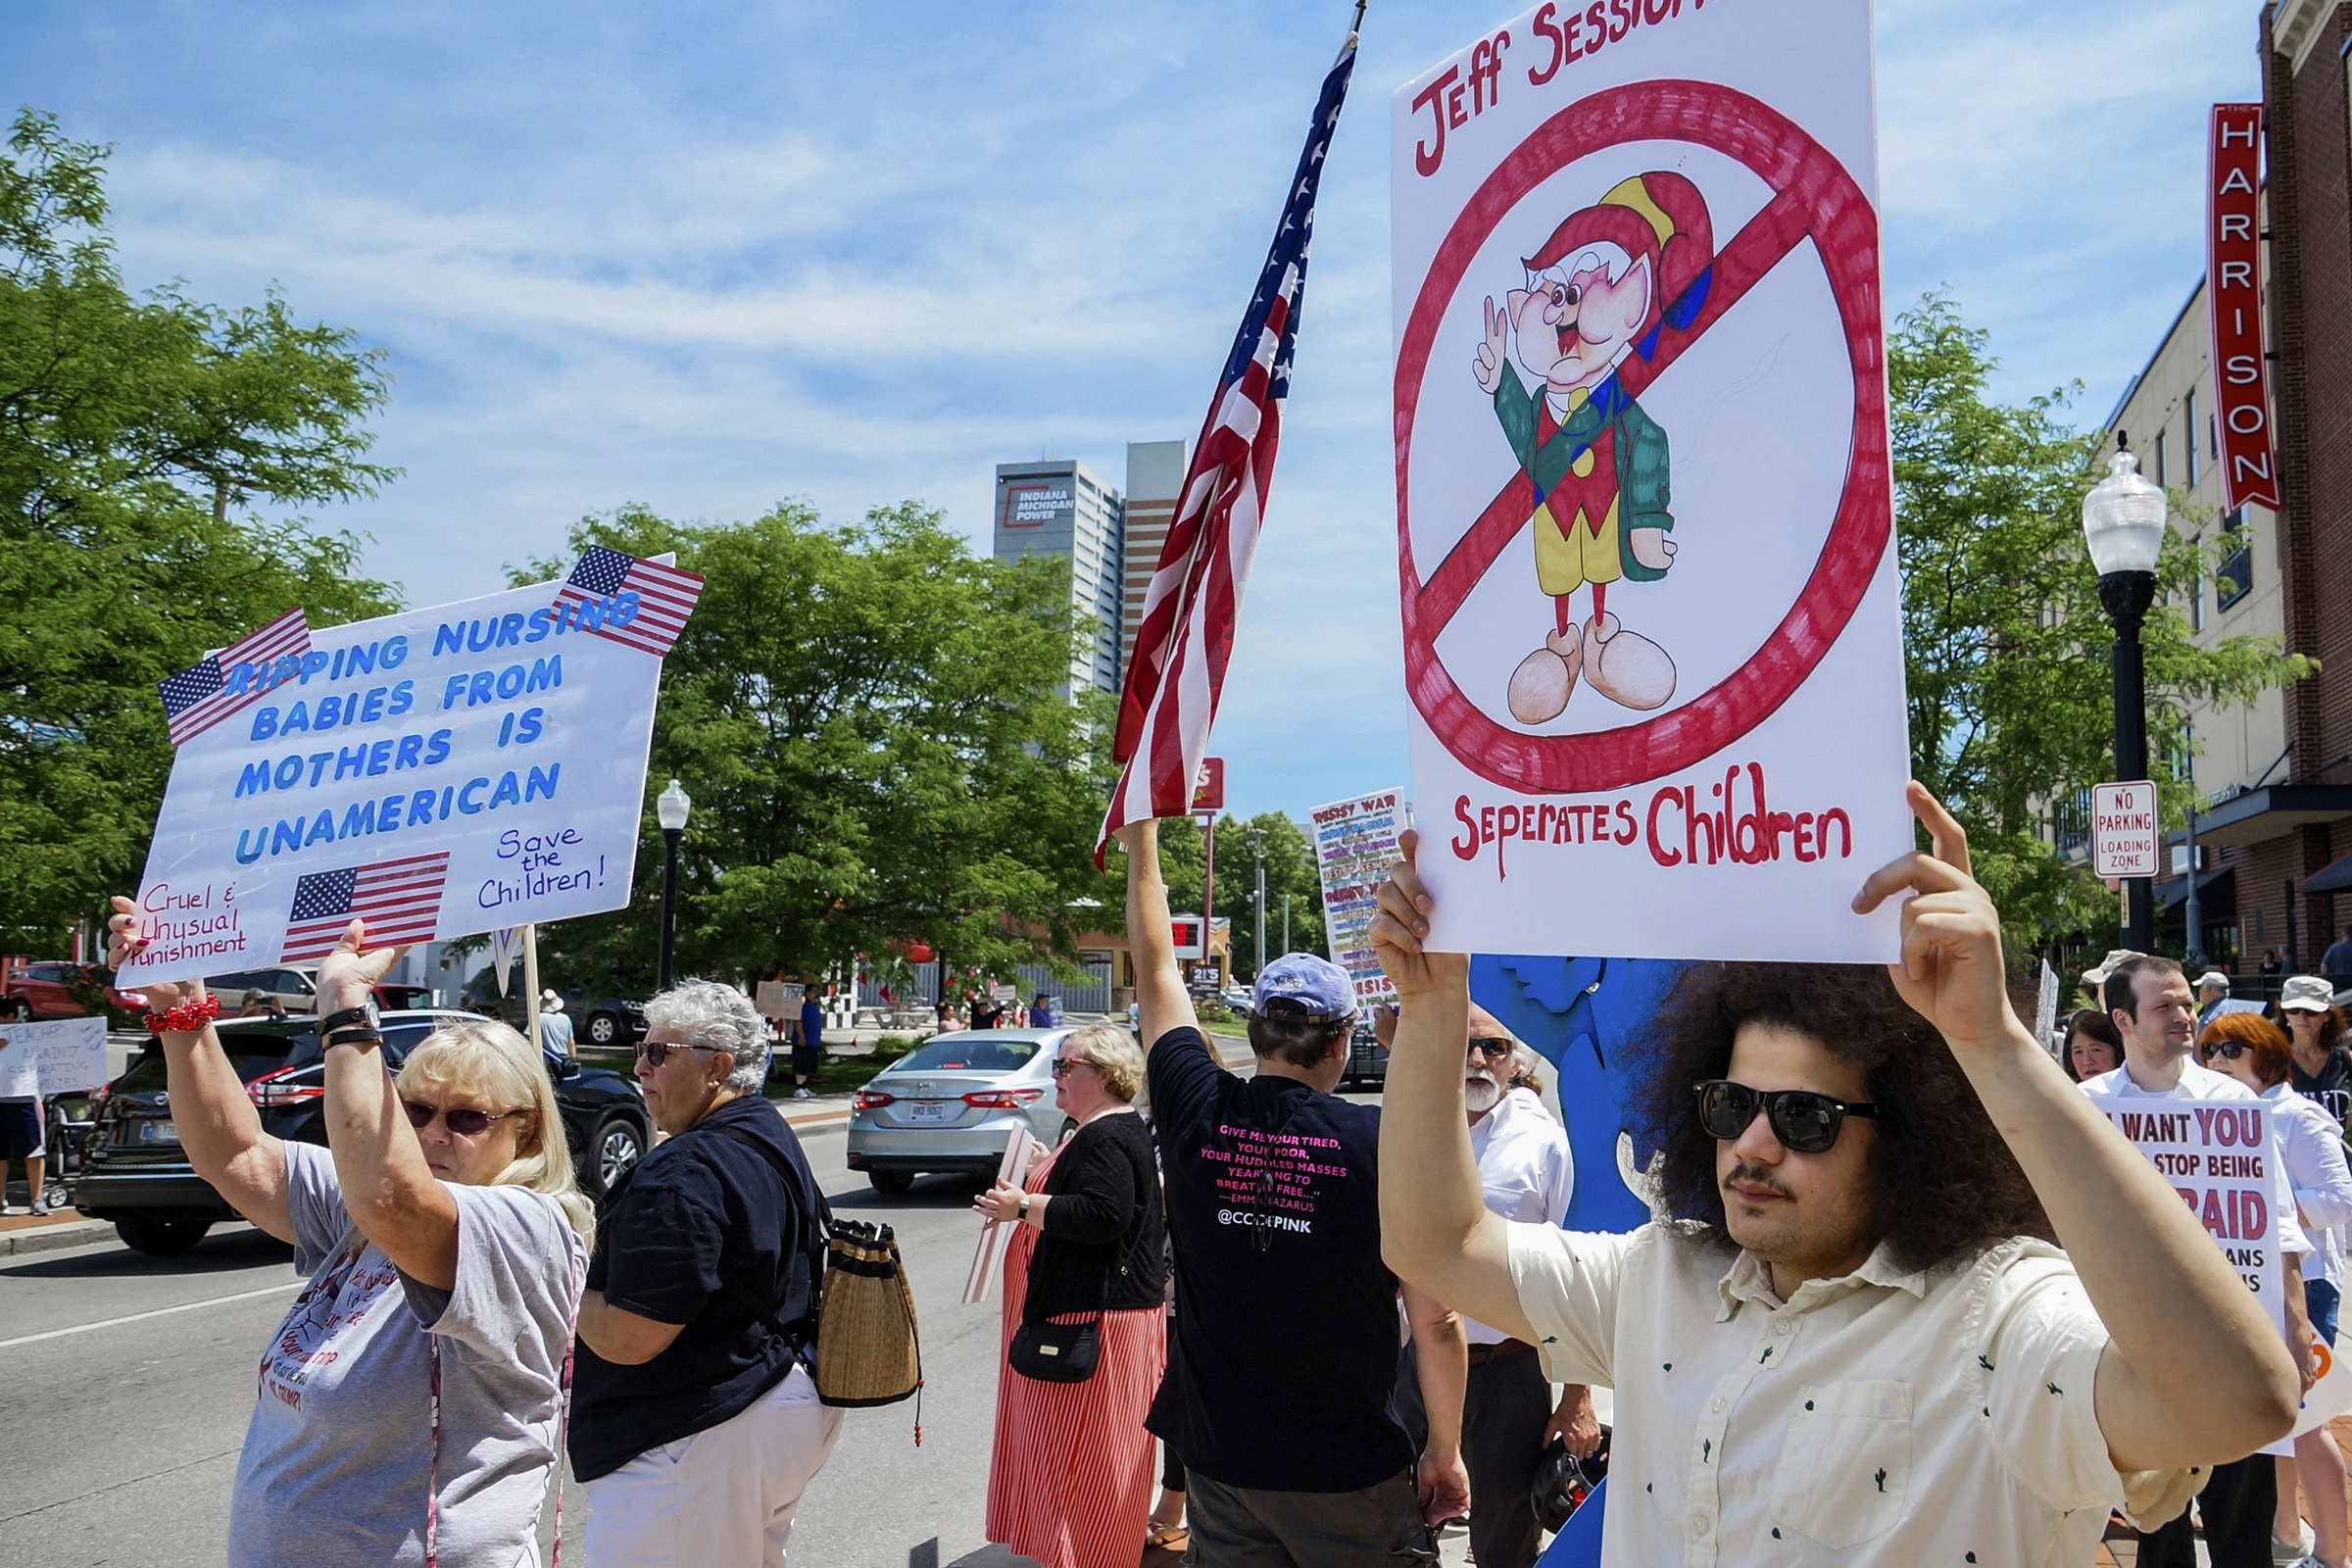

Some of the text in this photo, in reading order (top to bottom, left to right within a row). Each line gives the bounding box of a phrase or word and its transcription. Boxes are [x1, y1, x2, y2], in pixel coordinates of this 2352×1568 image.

[1527, 0, 1715, 86] SESSIO
[2220, 121, 2270, 483] HARRISON
[1017, 500, 1074, 512] MICHIGAN
[1020, 490, 1067, 502] INDIANA
[1016, 511, 1056, 521] POWER
[224, 592, 640, 697] RIPPING NURSING
[250, 654, 563, 742] BABIES FROM
[234, 707, 544, 799] MOTHERS IS
[234, 762, 561, 865] UNAMERICAN
[1313, 804, 1354, 824] RESIST
[1361, 795, 1396, 812] WAR
[2115, 792, 2133, 809] NO
[2099, 812, 2151, 832] PARKING
[497, 828, 583, 858] Save
[2100, 840, 2151, 854] LOADING
[521, 852, 563, 871] the
[2111, 855, 2141, 867] ZONE
[478, 855, 605, 908] Children!
[144, 883, 212, 912] Cruel
[141, 908, 238, 941] Unusual
[1352, 977, 1392, 995] ESIS
[1219, 1124, 1341, 1151] GIVE ME YOUR TIRED,
[2121, 1108, 2263, 1148] WANT YOU
[1200, 1148, 1231, 1162] YOUR
[1298, 1162, 1347, 1177] MASSES
[1275, 1148, 1309, 1160] POOR,
[2154, 1153, 2264, 1178] STOP BEING
[1228, 1167, 1311, 1186] YEARNG TO
[1268, 1196, 1314, 1212] LAZARUS
[2177, 1188, 2268, 1241] AID
